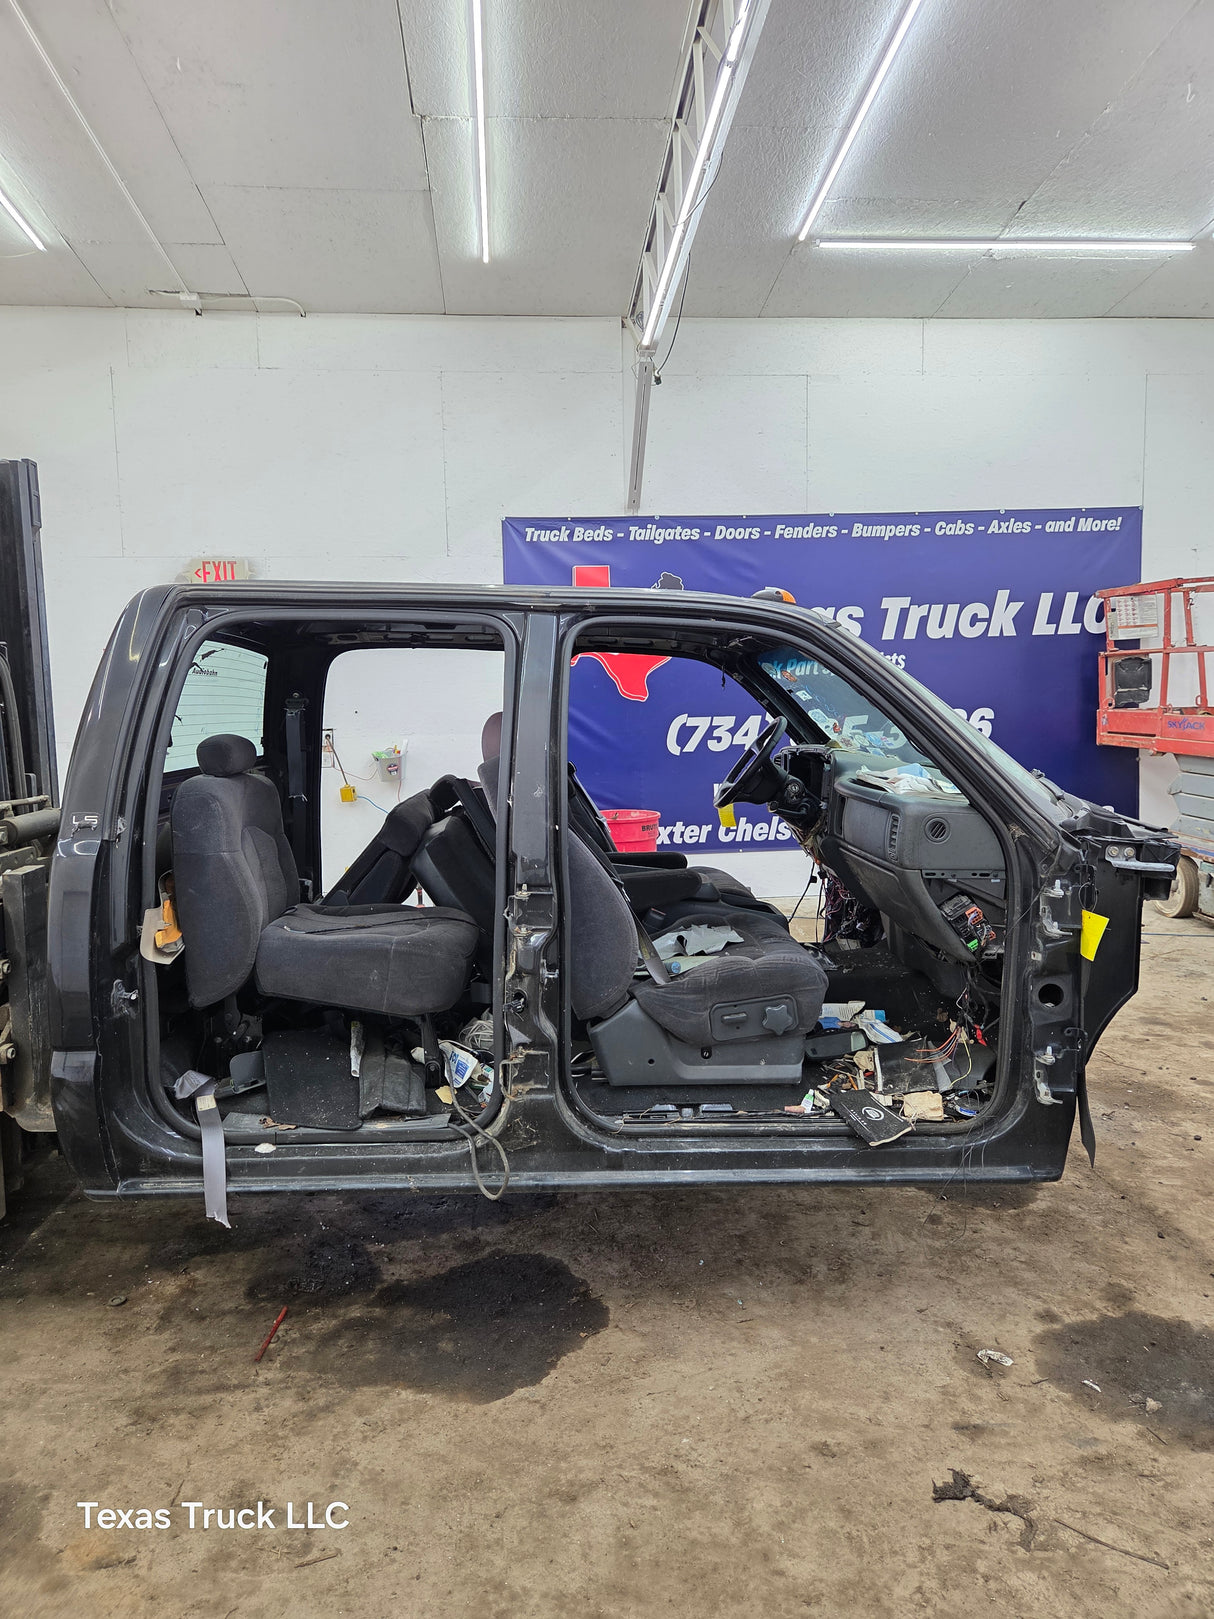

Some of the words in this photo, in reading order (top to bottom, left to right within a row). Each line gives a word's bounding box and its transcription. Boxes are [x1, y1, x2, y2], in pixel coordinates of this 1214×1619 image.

[525, 525, 571, 542] Truck
[572, 525, 614, 542] Beds
[628, 523, 701, 545] Tailgates
[714, 524, 761, 540] Doors
[774, 522, 839, 539] Fenders
[851, 521, 921, 541] Bumpers
[934, 519, 975, 536] Cabs
[986, 517, 1032, 535] Axles
[1044, 518, 1076, 533] and
[1077, 516, 1122, 532] More!
[201, 561, 237, 583] EXIT
[881, 589, 1024, 641] Truck
[666, 713, 775, 757] (734
[72, 815, 98, 825] LS
[717, 816, 798, 843] Chels
